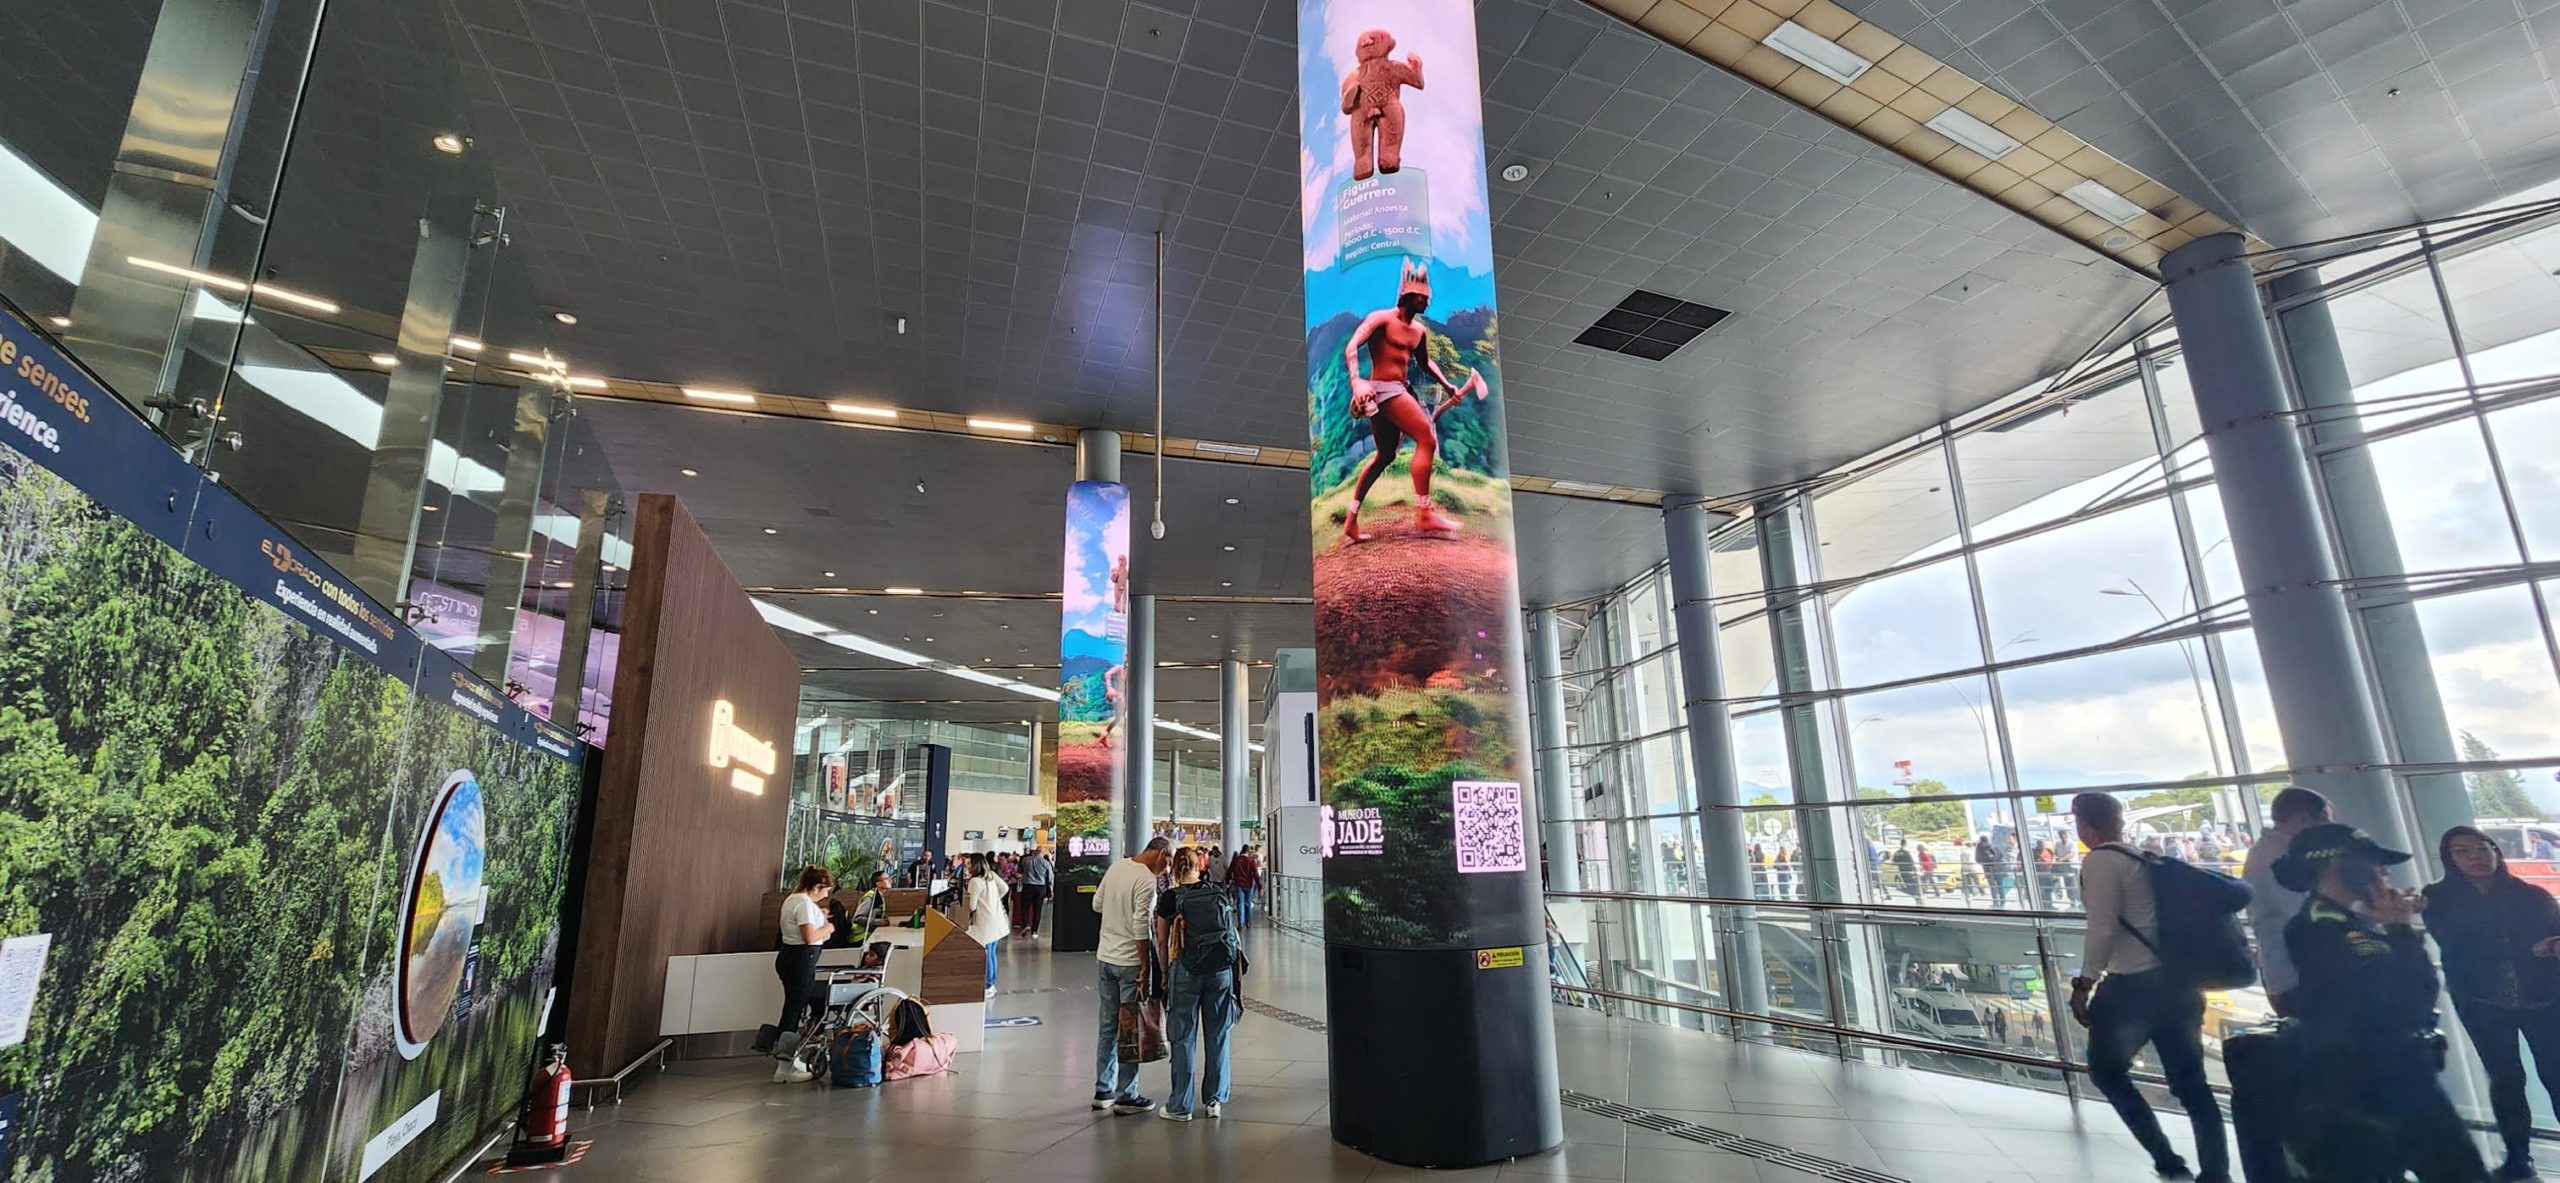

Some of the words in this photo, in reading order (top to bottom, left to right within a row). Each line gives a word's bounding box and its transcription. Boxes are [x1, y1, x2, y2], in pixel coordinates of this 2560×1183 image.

[1343, 179, 1379, 199] Figura
[1343, 187, 1396, 209] Guerrero
[1384, 227, 1405, 235] 1500
[1371, 239, 1400, 250] Central
[17, 355, 90, 424] senses.
[275, 579, 319, 617] Experiencia
[321, 580, 338, 601] con
[337, 587, 360, 615] todos
[1338, 808, 1364, 820] MUSEO
[1364, 807, 1382, 819] DEL
[1337, 819, 1384, 844] JADE
[1083, 841, 1111, 852] JADE
